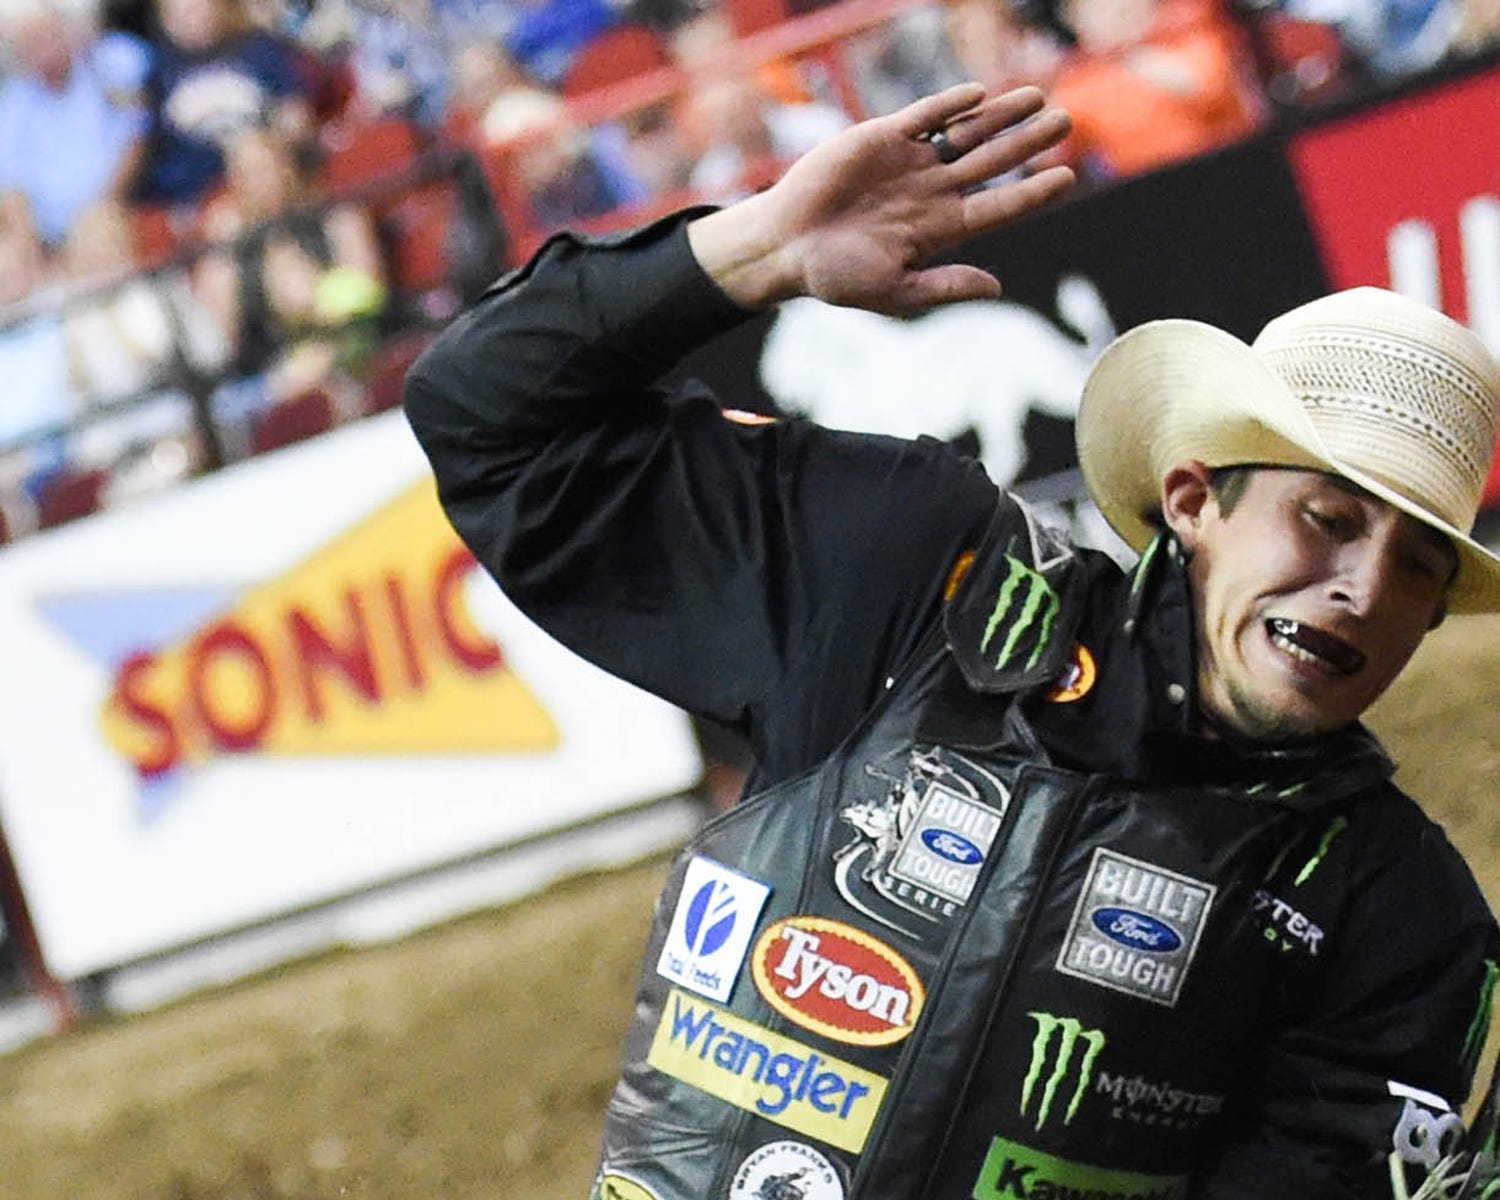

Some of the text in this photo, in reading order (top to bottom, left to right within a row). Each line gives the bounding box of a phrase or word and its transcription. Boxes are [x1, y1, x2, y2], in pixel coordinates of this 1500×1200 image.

[111, 544, 503, 778] SONIC
[1096, 860, 1207, 922] BUILT
[1110, 914, 1163, 946] Ford
[774, 925, 910, 1027] Tyson
[1073, 935, 1177, 993] TOUGH
[670, 995, 870, 1120] Wrangler
